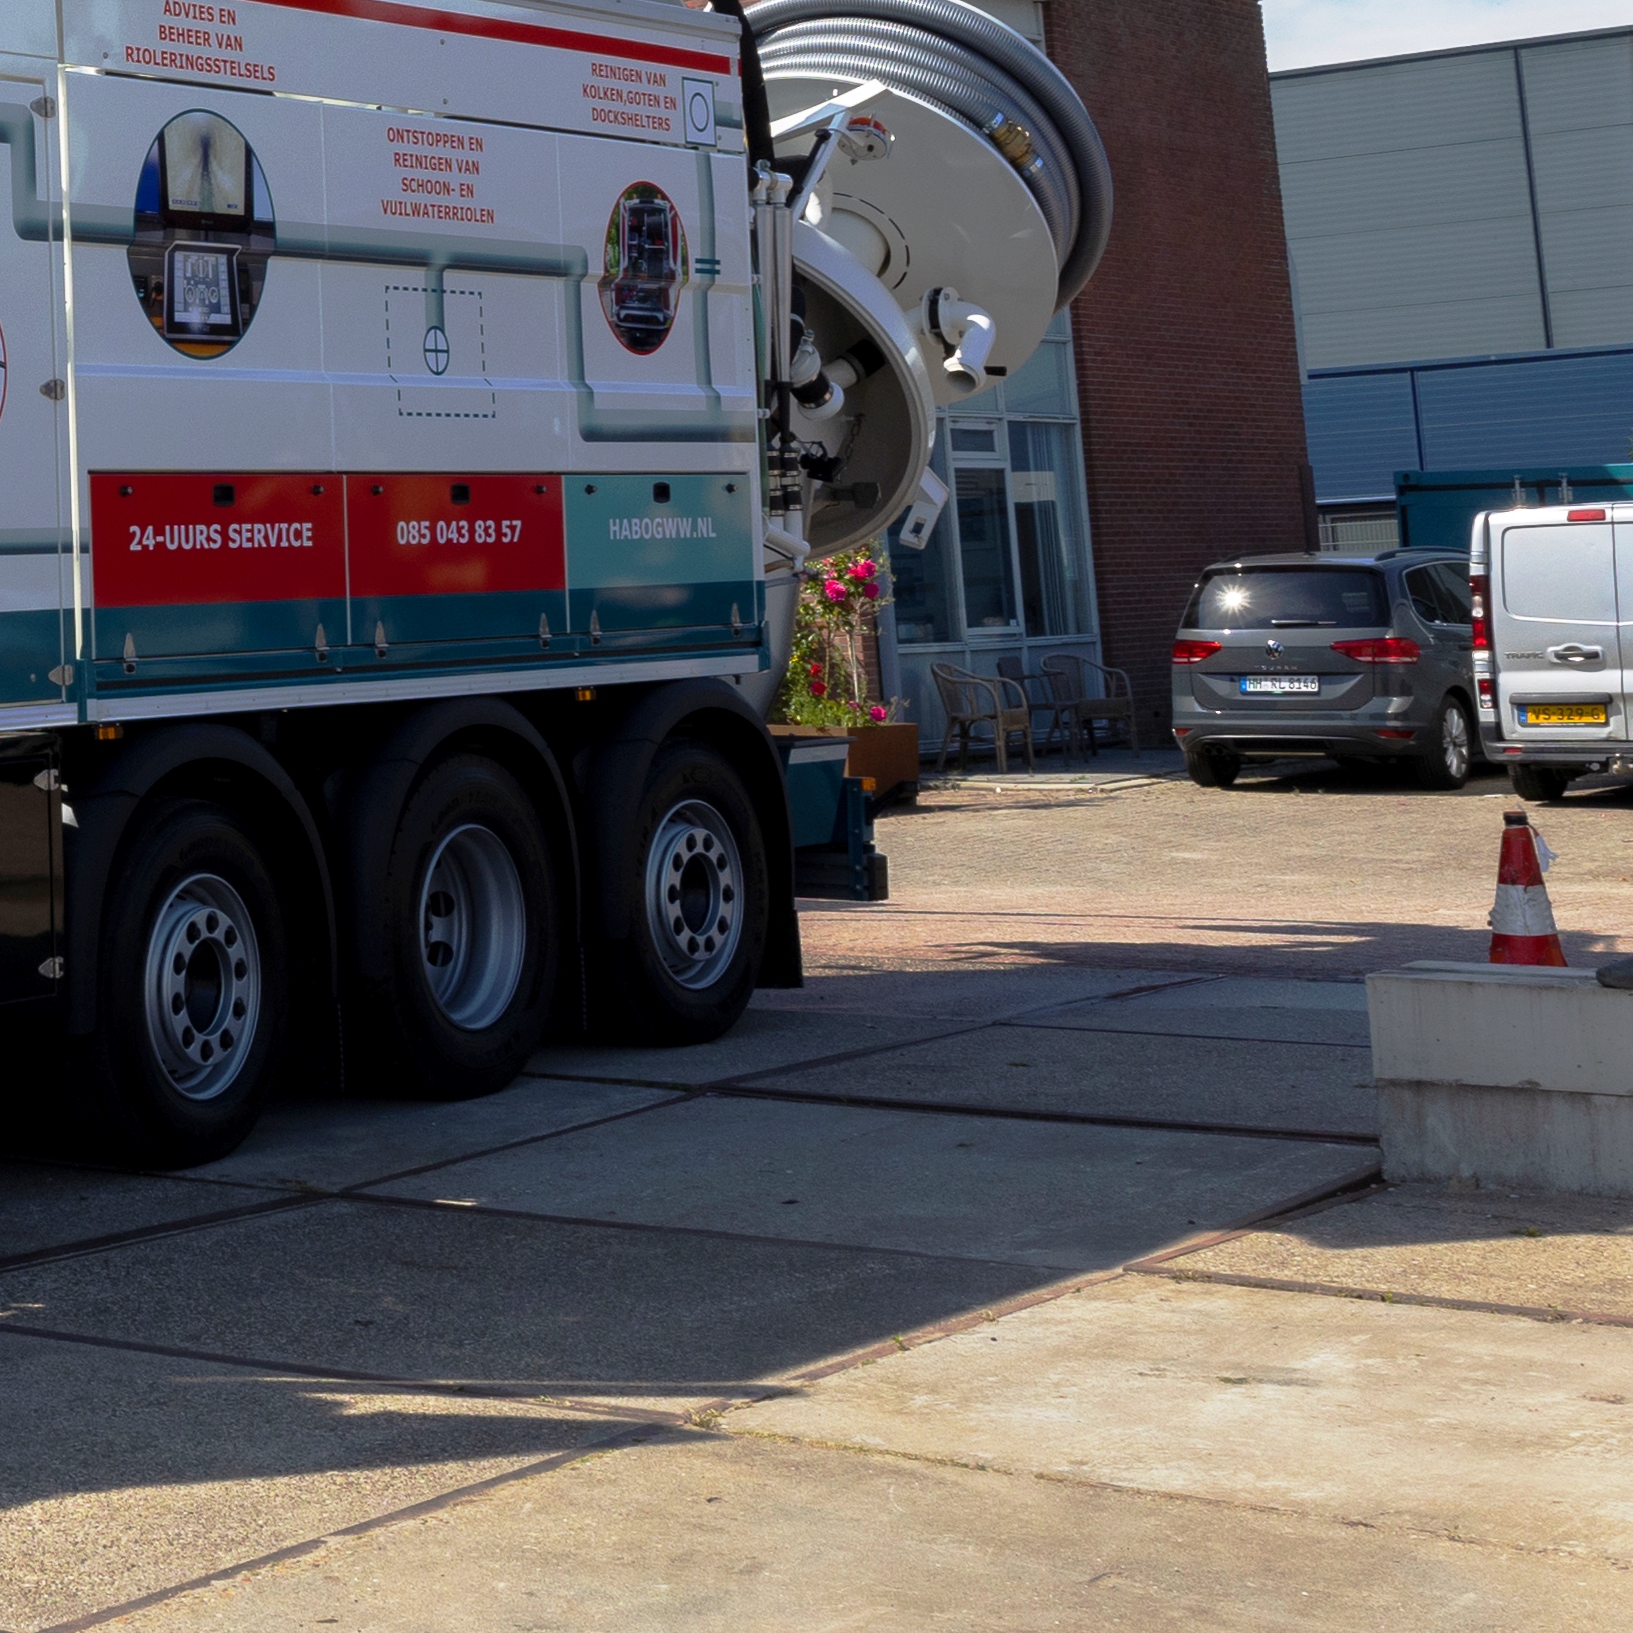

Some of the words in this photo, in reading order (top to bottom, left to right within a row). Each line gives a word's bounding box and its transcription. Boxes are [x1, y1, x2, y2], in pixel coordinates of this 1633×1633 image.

[163, 0, 214, 22] ADVIES
[219, 8, 236, 25] EN
[158, 24, 212, 48] BEHEER
[215, 33, 243, 52] VAN
[125, 45, 276, 82] RIOLERINGSSTELSELS
[591, 62, 643, 84] REINIGEN
[645, 71, 667, 87] VAN
[664, 96, 677, 111] EN
[591, 107, 671, 132] DOCKSHELTERS
[387, 127, 465, 150] ONTSTOPPEN
[468, 136, 483, 152] EN
[393, 152, 453, 172] REINIGEN
[456, 158, 480, 175] VAN
[401, 177, 456, 196] SCHOON-
[459, 183, 474, 198] EN
[380, 199, 494, 224] VUILWATERRIOLEN
[129, 524, 223, 551] 24-UURS
[228, 522, 313, 548] SERVICE
[396, 521, 431, 545] 085
[436, 521, 469, 544] 043
[474, 520, 496, 543] 83
[501, 520, 522, 543] 57
[609, 517, 717, 540] HABOGWW.NL
